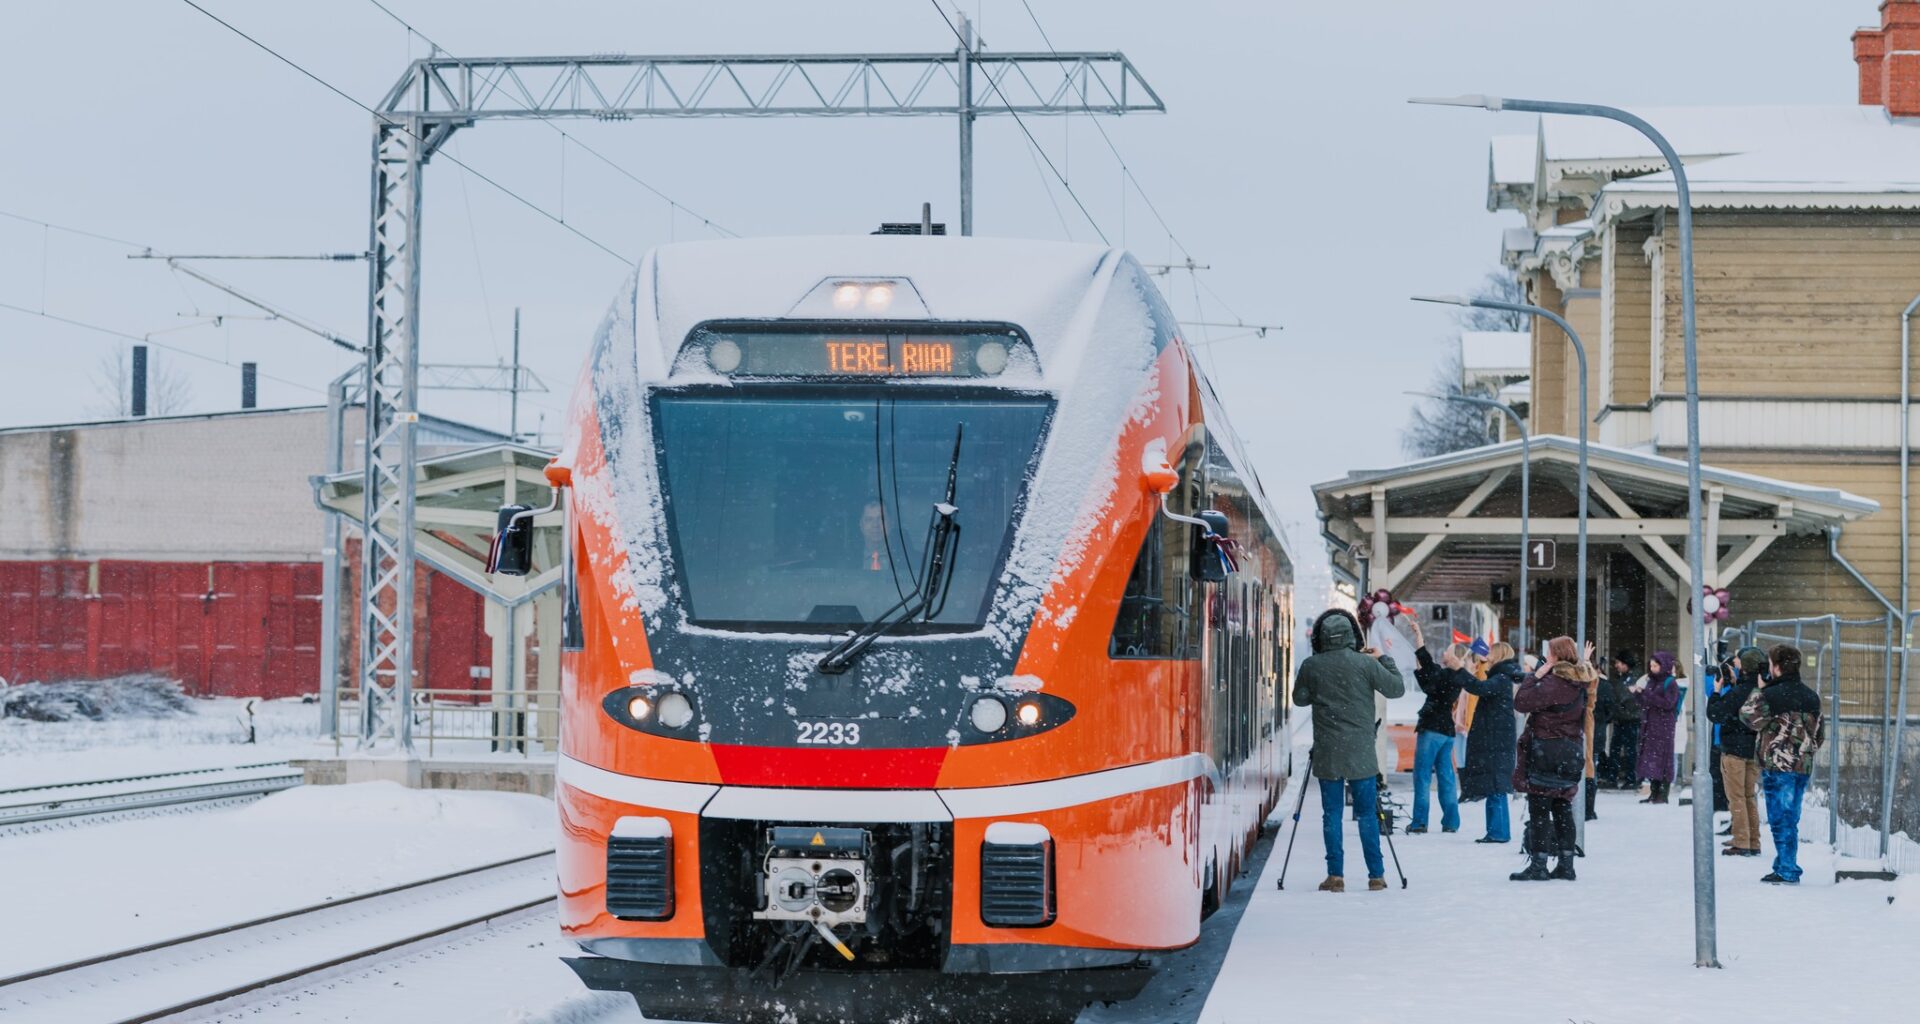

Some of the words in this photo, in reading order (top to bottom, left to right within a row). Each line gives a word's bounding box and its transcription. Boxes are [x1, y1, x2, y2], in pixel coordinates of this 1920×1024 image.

[826, 342, 895, 372] TERE,
[902, 343, 953, 372] RIIA!
[1533, 543, 1544, 566] 1
[1497, 586, 1505, 602] 1
[797, 722, 860, 745] 2233
